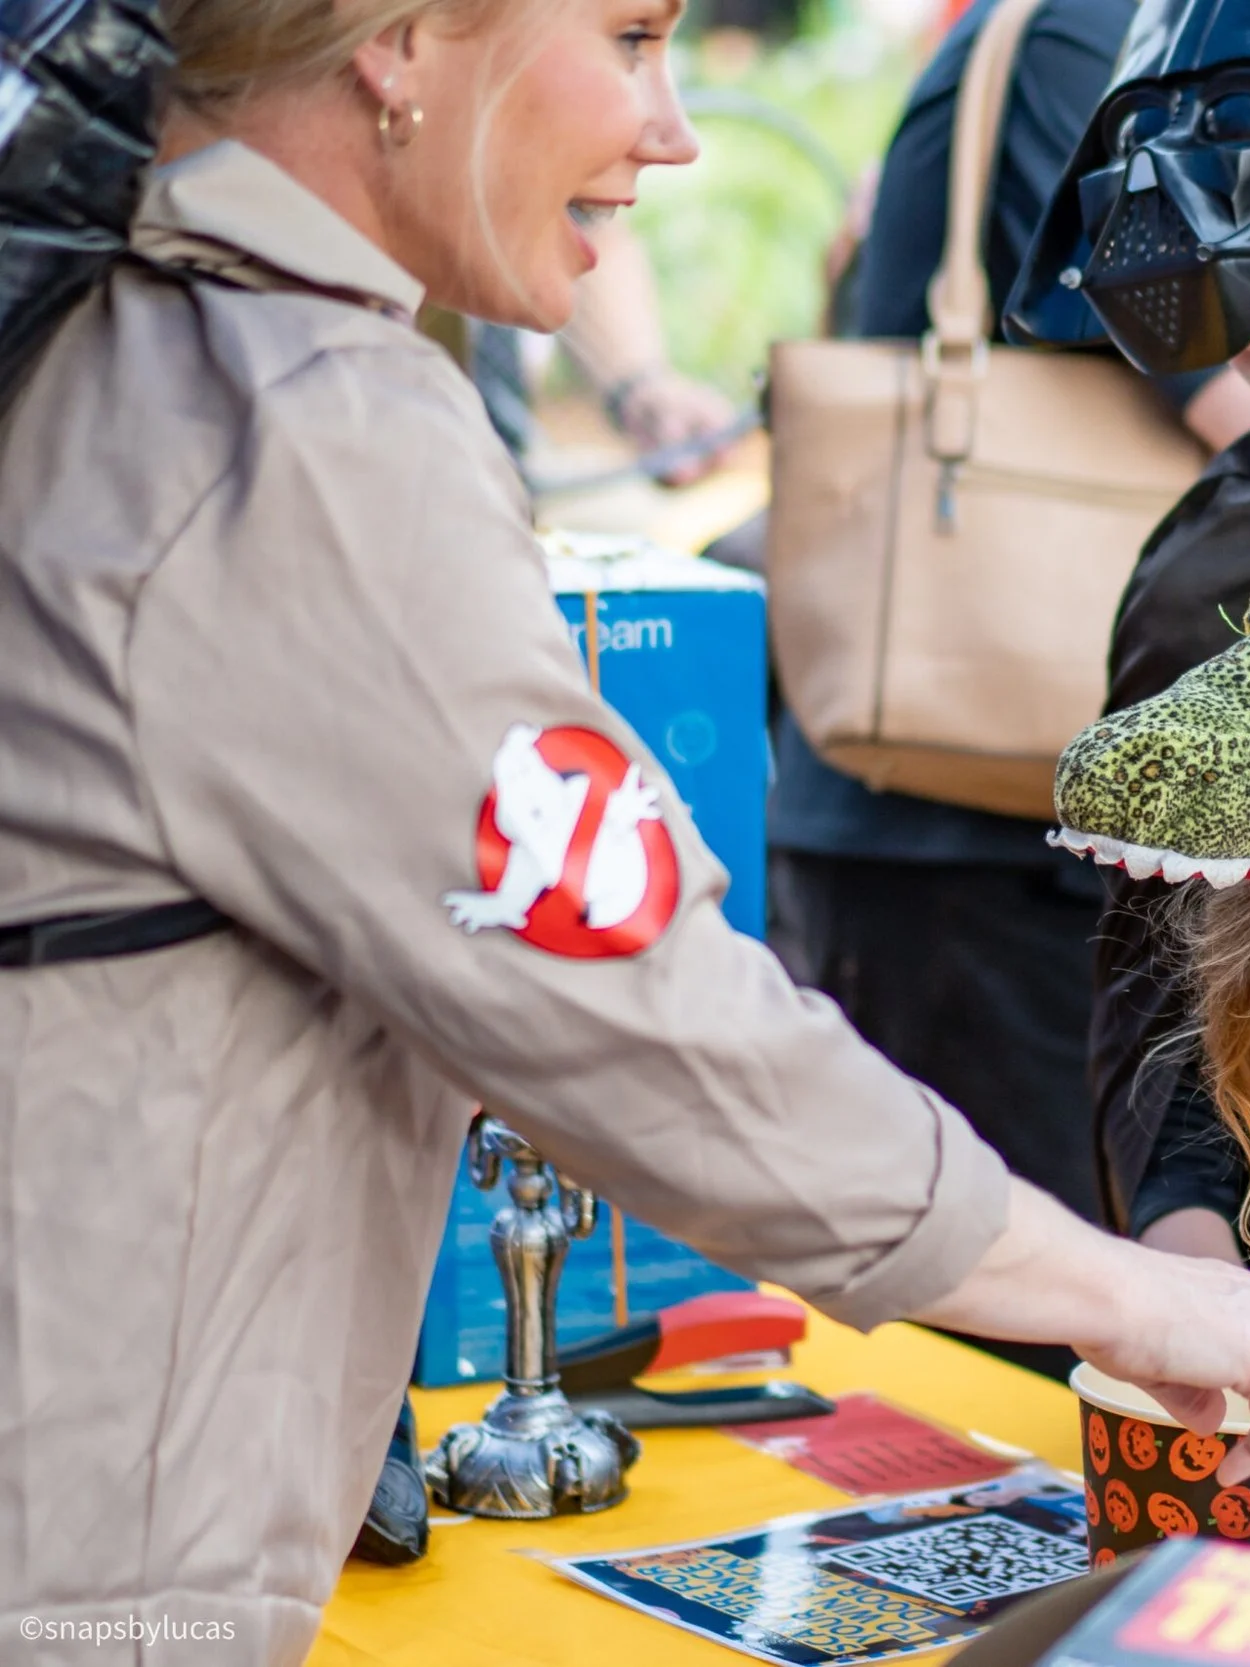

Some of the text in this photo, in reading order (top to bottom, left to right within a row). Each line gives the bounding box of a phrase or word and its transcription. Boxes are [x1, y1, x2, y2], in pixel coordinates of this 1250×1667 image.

[636, 1564, 707, 1592] FOR
[692, 1590, 772, 1626] ERE
[811, 1597, 884, 1625] WIN
[837, 1584, 935, 1621] DOOR
[791, 1608, 880, 1643] YOUR
[875, 1621, 927, 1641] TO
